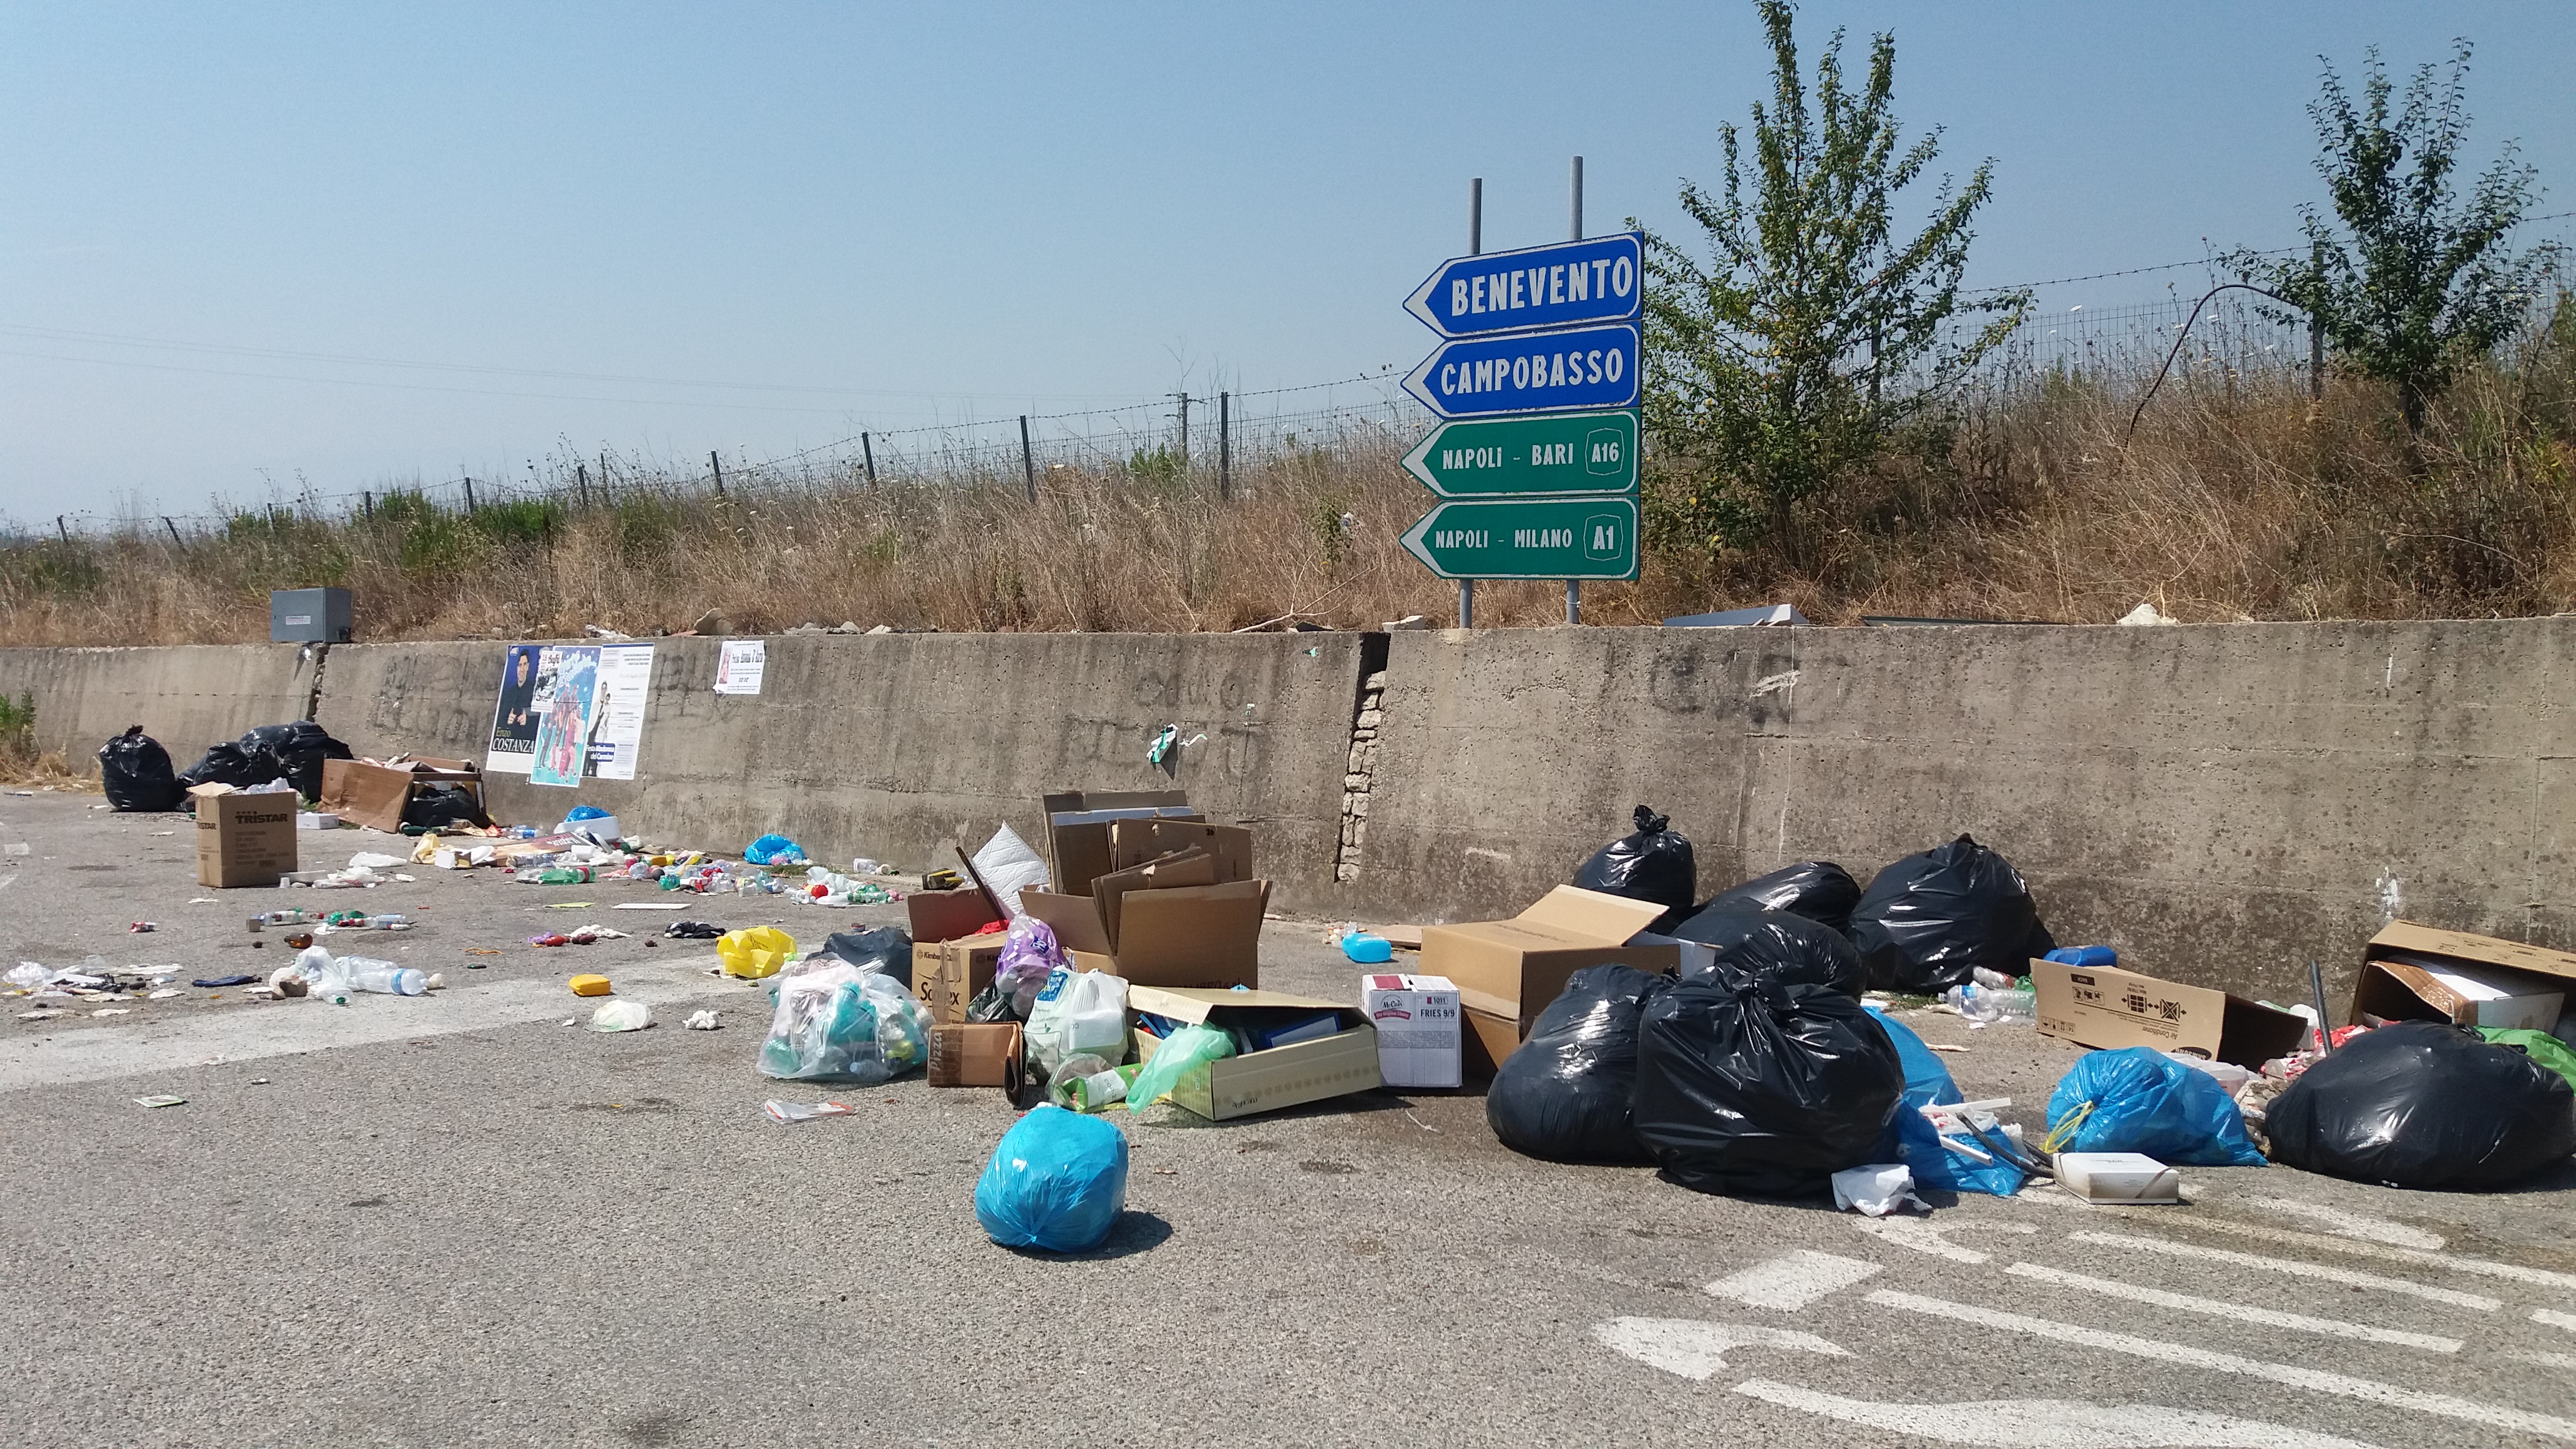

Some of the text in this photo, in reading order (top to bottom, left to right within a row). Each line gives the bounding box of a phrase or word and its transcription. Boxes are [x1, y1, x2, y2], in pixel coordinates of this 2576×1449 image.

[1451, 256, 1633, 316] BENEVENTO
[1441, 348, 1623, 396] CAMPOBASSO
[1443, 446, 1502, 469] NAPOLI
[1531, 443, 1573, 466] BARI
[1591, 442, 1619, 463] A16
[1435, 529, 1488, 548] NAPOLI
[1514, 528, 1573, 548] MILANO
[1593, 525, 1614, 550] A1
[496, 727, 511, 737] Enzo
[492, 738, 535, 753] COSTANZA
[235, 813, 288, 824] TRISTAR
[1382, 1000, 1403, 1008] McCain
[1420, 1009, 1455, 1018] FRIES 9/9
[2142, 1027, 2169, 1038] Conditioner
